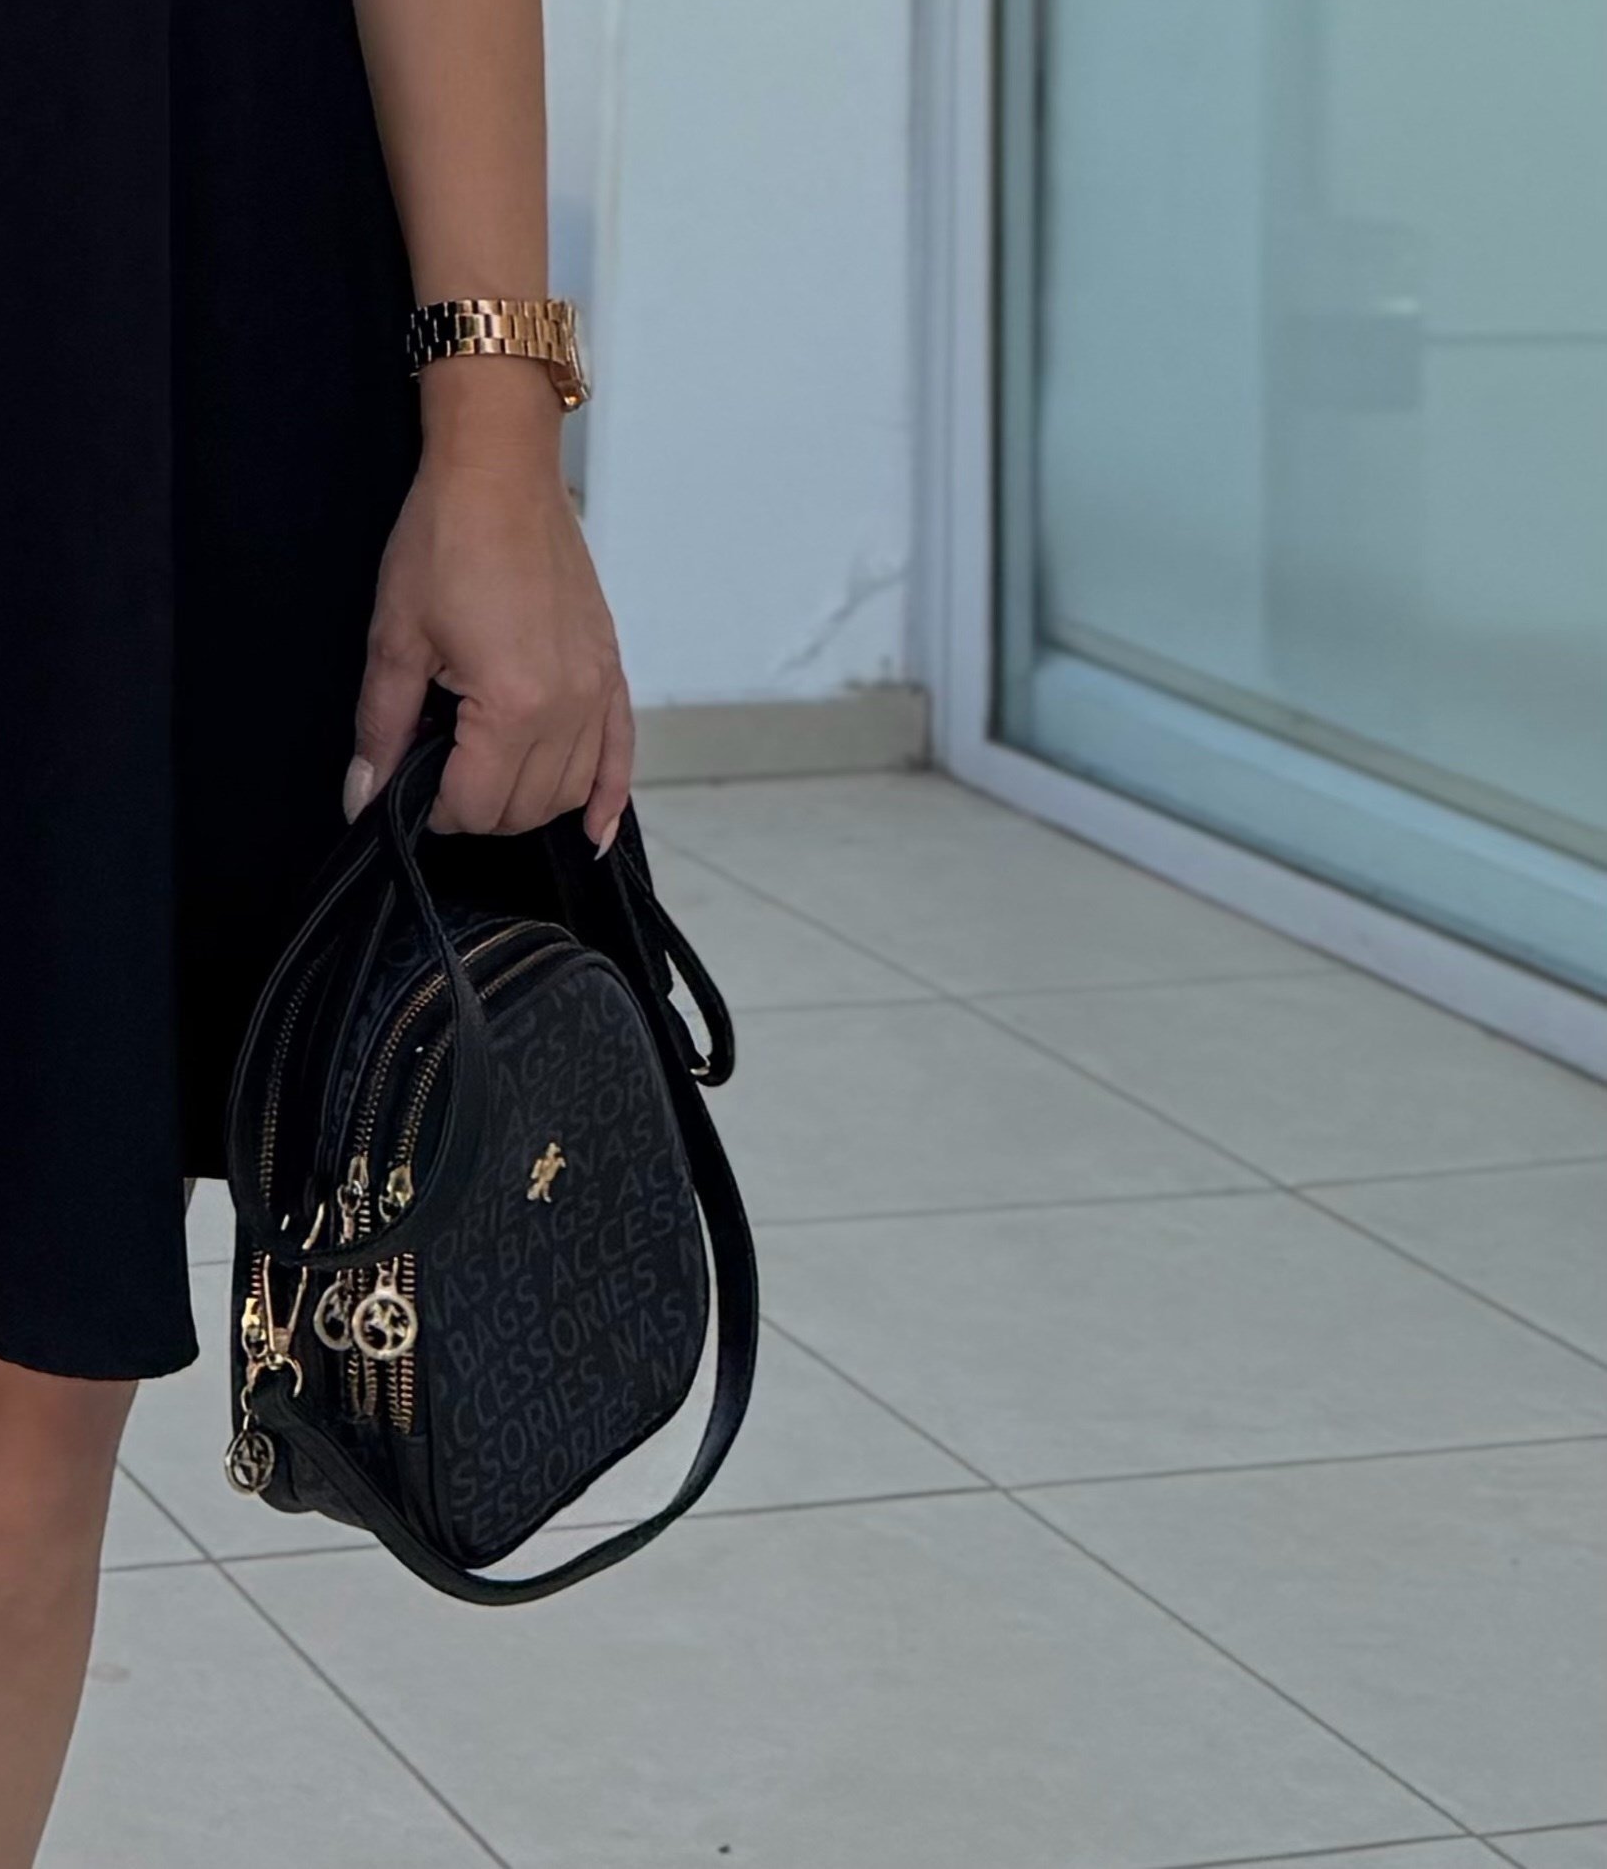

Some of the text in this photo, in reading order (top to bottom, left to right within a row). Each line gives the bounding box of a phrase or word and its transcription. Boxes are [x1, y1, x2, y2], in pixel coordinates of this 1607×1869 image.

[497, 1182, 602, 1279] BAGS
[446, 1274, 540, 1381] BAGS
[608, 1289, 687, 1376] NAS
